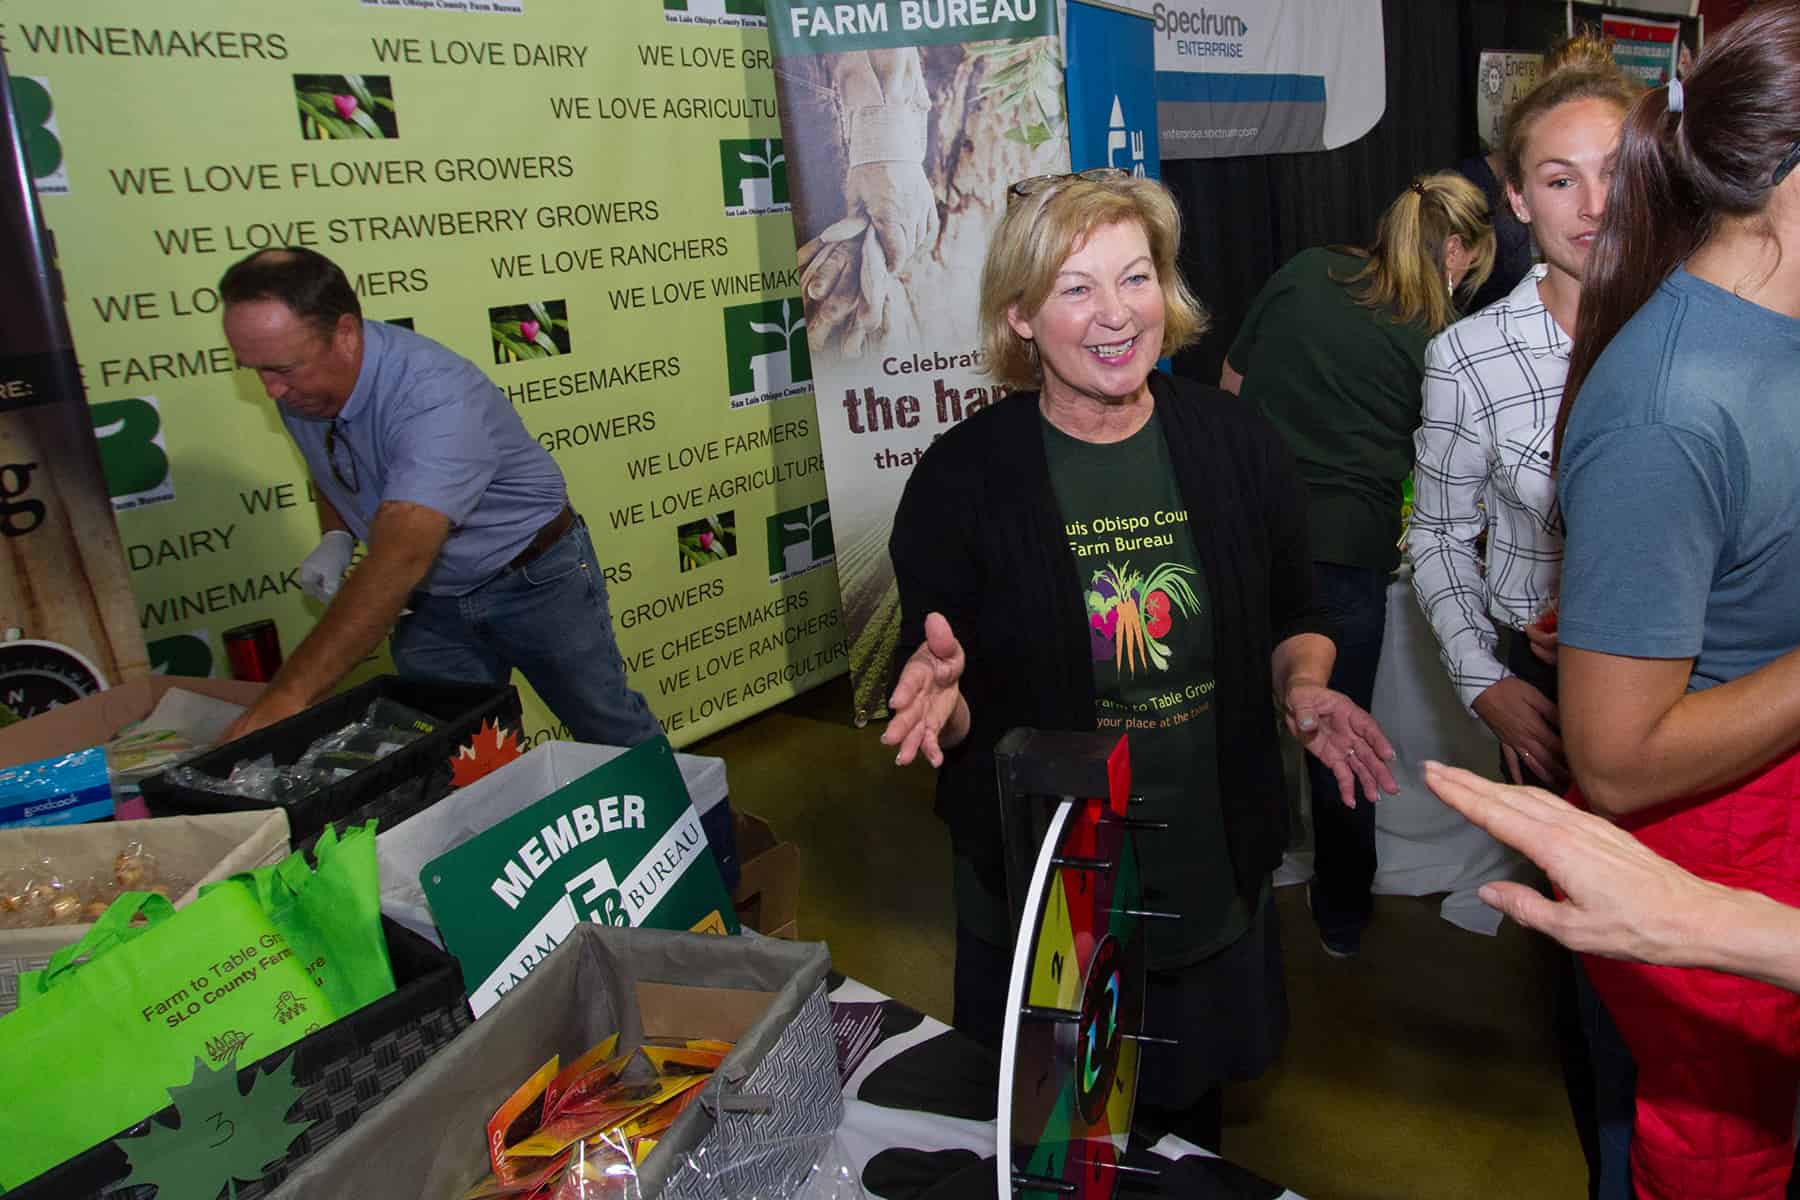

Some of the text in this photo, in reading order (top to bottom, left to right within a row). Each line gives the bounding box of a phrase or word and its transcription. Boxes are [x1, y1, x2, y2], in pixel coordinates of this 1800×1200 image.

[790, 0, 1037, 39] FARM BUREAU
[1152, 4, 1242, 40] Spectrum
[20, 24, 289, 60] WINEMAKERS
[372, 37, 589, 68] WE LOVE DAIRY
[638, 45, 774, 69] WE LOVE GR
[1176, 40, 1243, 58] ENTERPRISE
[550, 97, 592, 119] WE
[599, 97, 657, 119] LOVE
[109, 155, 574, 196] WE LOVE FLOWER GROWERS
[154, 200, 660, 255] WE LOVE STRAWBERRY GROWERS
[491, 236, 729, 279] WE LOVE RANCHERS
[92, 293, 160, 323] WE
[608, 286, 648, 311] WE
[651, 279, 706, 306] LOVE
[100, 347, 241, 388] FARME
[497, 356, 681, 405] HEESEMAKERS
[843, 384, 921, 435] the
[537, 411, 657, 453] GROWERS
[626, 419, 809, 480] WE LOVE FARMERS
[873, 448, 924, 470] that
[239, 483, 297, 515] WE
[609, 504, 645, 530] WE
[650, 488, 703, 519] LOVE
[1092, 515, 1150, 534] Obispo
[1153, 509, 1189, 526] Cou
[127, 524, 236, 571] DAIRY
[1114, 533, 1174, 553] Bureau
[620, 578, 725, 629] GROWERS
[660, 590, 809, 662] CHEESEMAKERS
[658, 608, 839, 696] WE LOVE RANCHERS
[689, 690, 738, 724] LOVE
[742, 639, 848, 701] AGRICULTUR
[1149, 692, 1184, 711] Table
[1125, 717, 1157, 731] place
[490, 794, 646, 910] MEMBER
[628, 821, 701, 910] BUREAU
[142, 986, 190, 1023] Farm
[190, 975, 210, 992] to
[208, 943, 259, 980] Table
[166, 1002, 202, 1029] SLO
[203, 967, 259, 1008] County
[204, 1111, 236, 1149] 3
